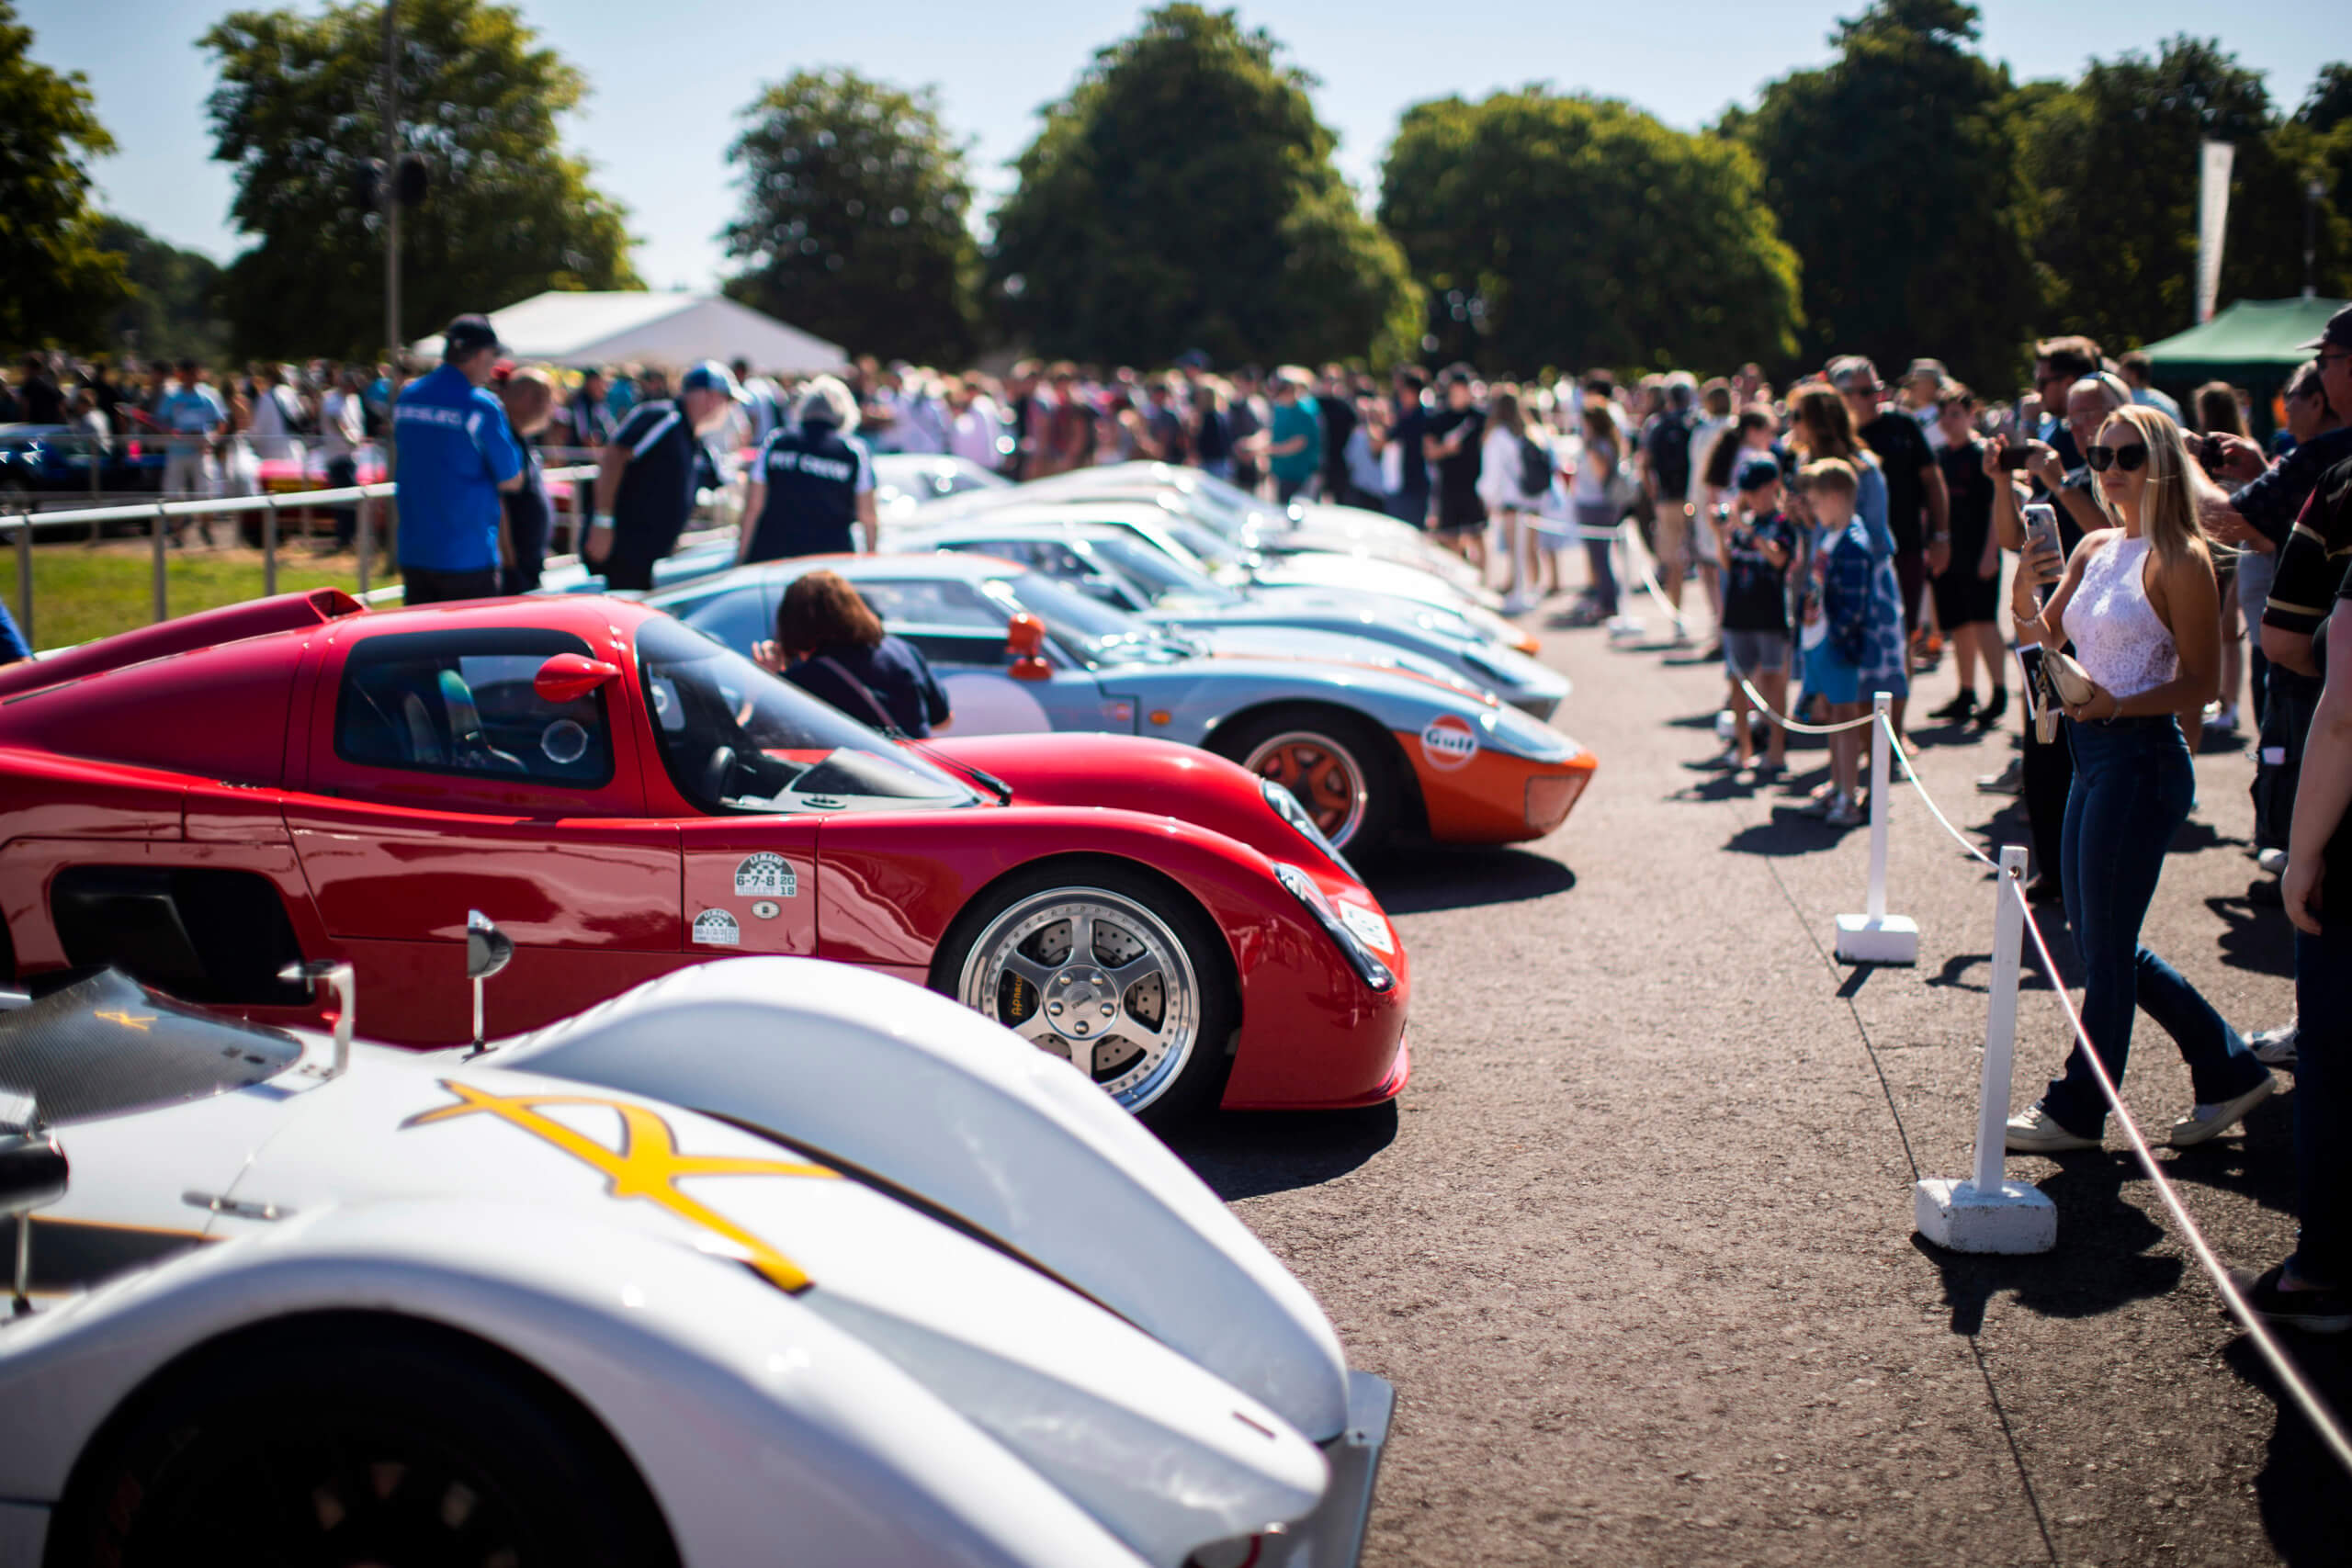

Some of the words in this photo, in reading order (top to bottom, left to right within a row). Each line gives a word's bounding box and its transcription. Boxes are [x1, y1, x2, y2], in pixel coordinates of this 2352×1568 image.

[799, 454, 851, 480] CREW
[1426, 728, 1474, 752] Gulf
[762, 852, 784, 865] MANS
[736, 875, 775, 886] 6-7-8
[780, 875, 795, 886] 20
[781, 886, 795, 896] 18
